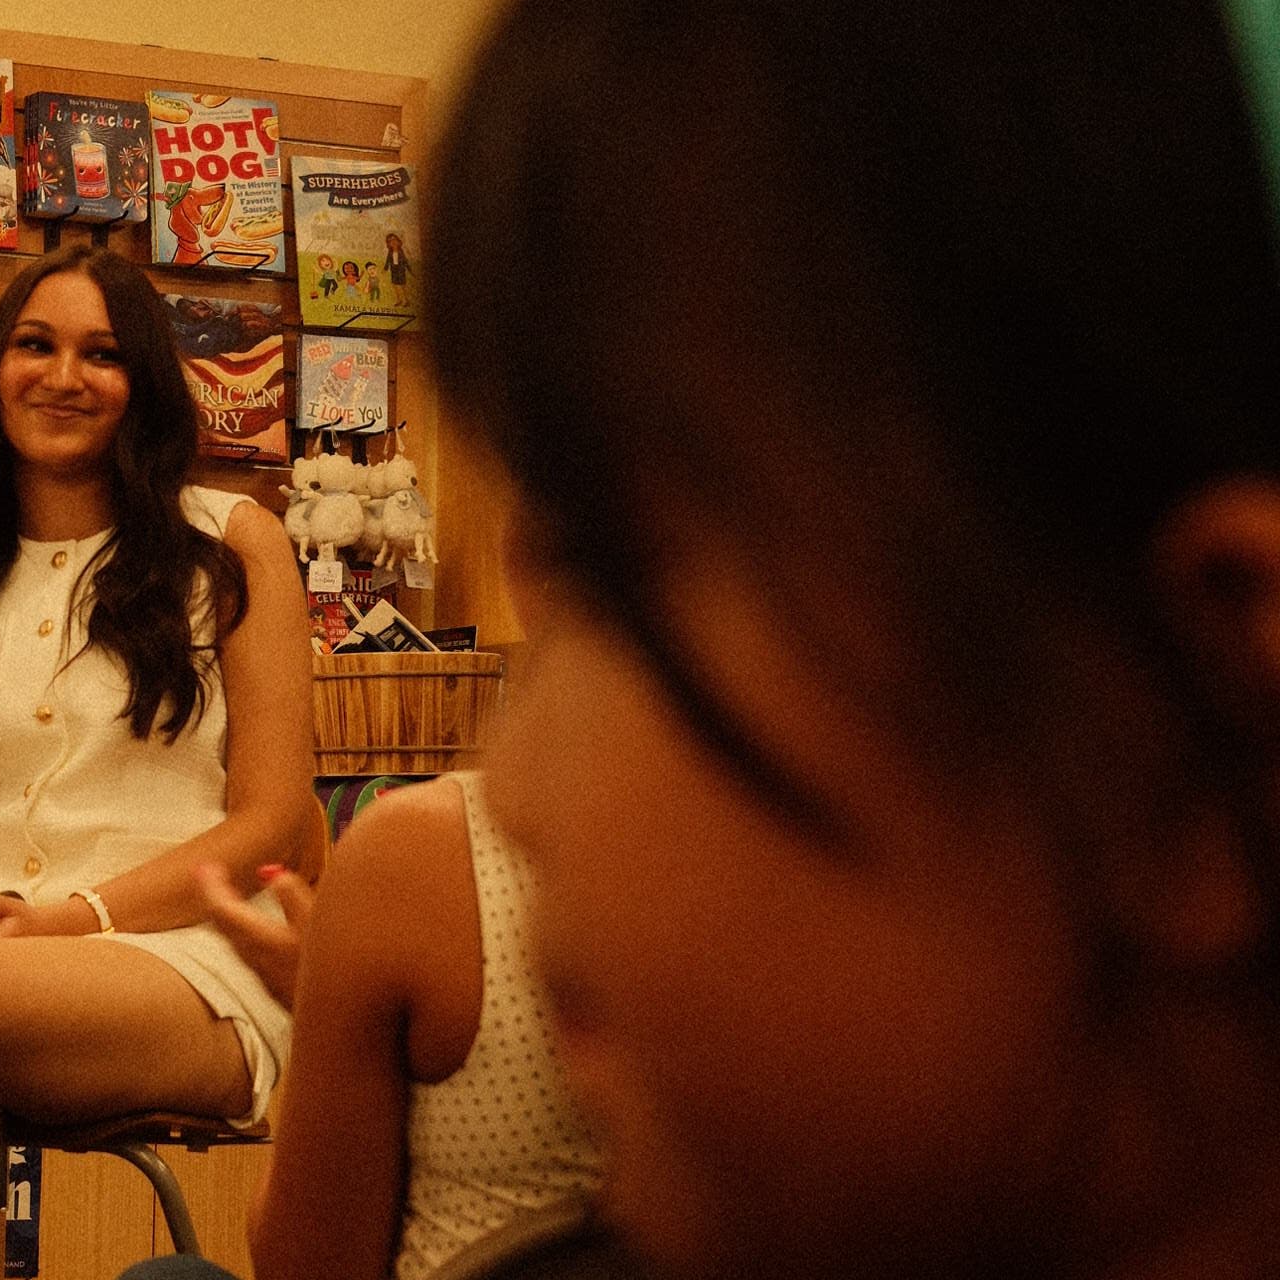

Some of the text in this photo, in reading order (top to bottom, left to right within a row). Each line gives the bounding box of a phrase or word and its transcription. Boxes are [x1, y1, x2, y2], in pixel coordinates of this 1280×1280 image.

[89, 100, 98, 109] My
[48, 101, 141, 130] Firecracker
[154, 121, 254, 155] HOT
[247, 182, 277, 190] History
[308, 172, 402, 190] SUPERHEROES
[240, 197, 274, 205] Favorite
[333, 191, 404, 206] Are Everywhere
[356, 354, 385, 367] BLUE
[306, 401, 383, 424] I LOVE YOU
[316, 593, 381, 605] CELEBRATE
